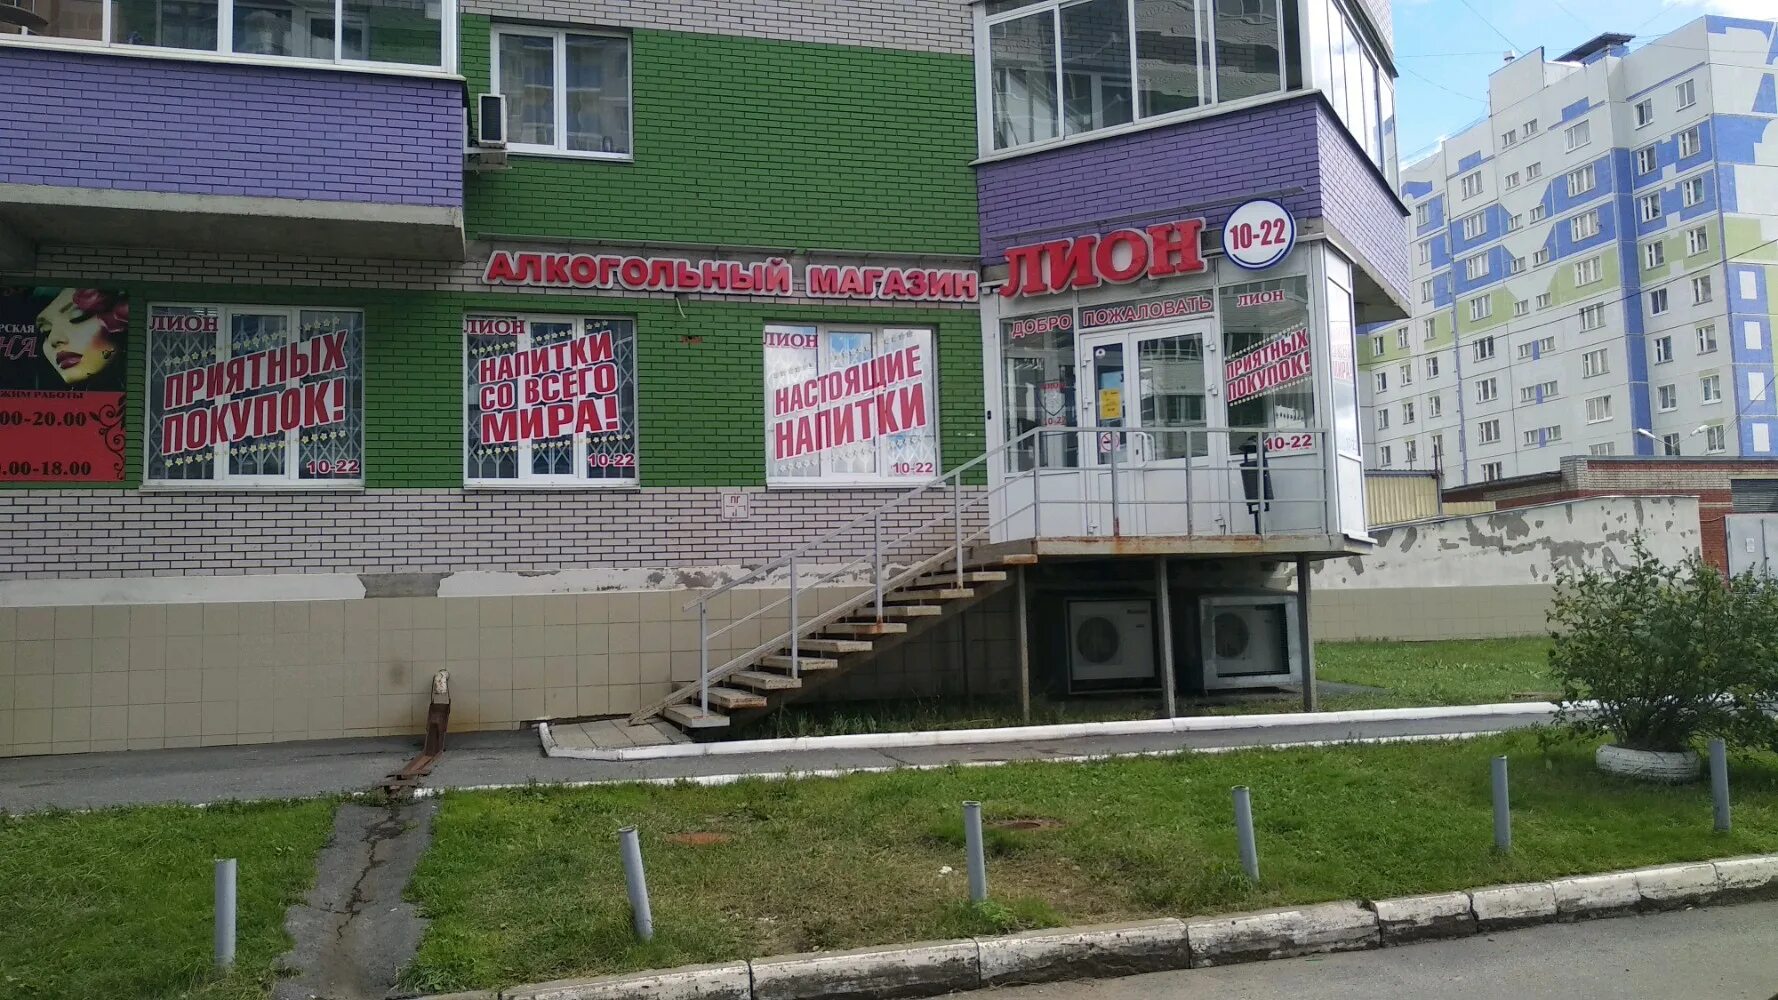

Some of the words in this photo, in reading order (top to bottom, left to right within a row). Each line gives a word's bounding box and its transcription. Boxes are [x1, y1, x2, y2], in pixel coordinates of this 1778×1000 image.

[1230, 218, 1286, 250] 10-22
[486, 251, 791, 295] АЛКОГОЛЬНЫЙ
[809, 266, 978, 299] МАГАЗИН
[999, 218, 1206, 298] ЛИОН
[1011, 313, 1073, 338] ДОБРО
[1082, 296, 1213, 328] ПОЖАЛОВАТЬ
[1237, 289, 1285, 307] ЛИОН
[150, 314, 219, 333] ЛИОН
[464, 319, 526, 335] ЛИОН
[763, 332, 819, 349] ЛИОН
[163, 329, 348, 410] ПРИЯТНЫХ
[479, 331, 614, 384] НАПИТКИ
[1226, 328, 1309, 381] ПРИЯТНЫХ
[34, 391, 84, 399] РАБОТЫ
[480, 382, 515, 411] СО
[524, 363, 618, 405] ВСЕГО
[774, 345, 922, 416] НАСТОЯЩИЕ
[1227, 350, 1311, 402] ПОКУПОК!
[161, 376, 347, 456] ПОКУПОК!
[480, 395, 621, 445] МИРА!
[774, 383, 927, 460] НАПИТКИ
[588, 453, 635, 467] 10-22
[1264, 434, 1312, 451] 10-22
[0, 461, 91, 476] .00-18.00
[306, 459, 360, 474] 10-22
[892, 462, 934, 475] 10-22
